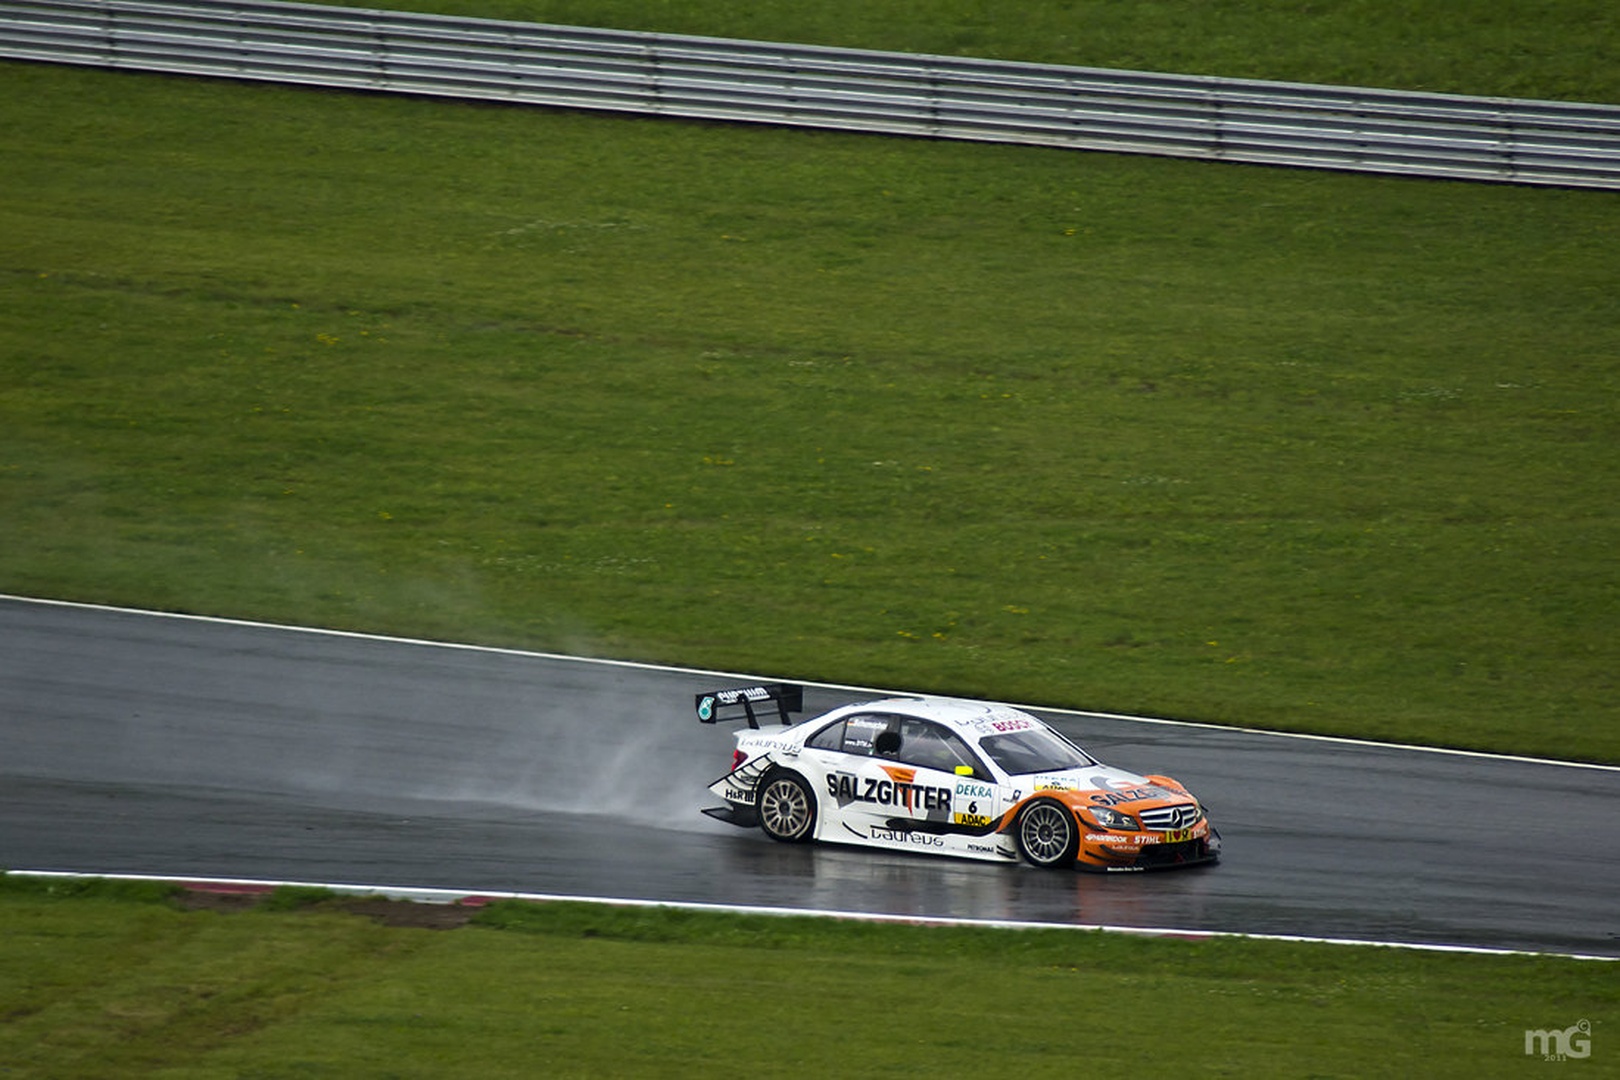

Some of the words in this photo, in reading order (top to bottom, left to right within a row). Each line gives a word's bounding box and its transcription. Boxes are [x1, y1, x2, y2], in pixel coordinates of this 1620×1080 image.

[826, 773, 952, 812] SALZGITTER
[956, 784, 993, 799] DEKRA
[968, 801, 978, 814] 6
[961, 813, 987, 827] ADAC
[1133, 835, 1161, 844] STIHL
